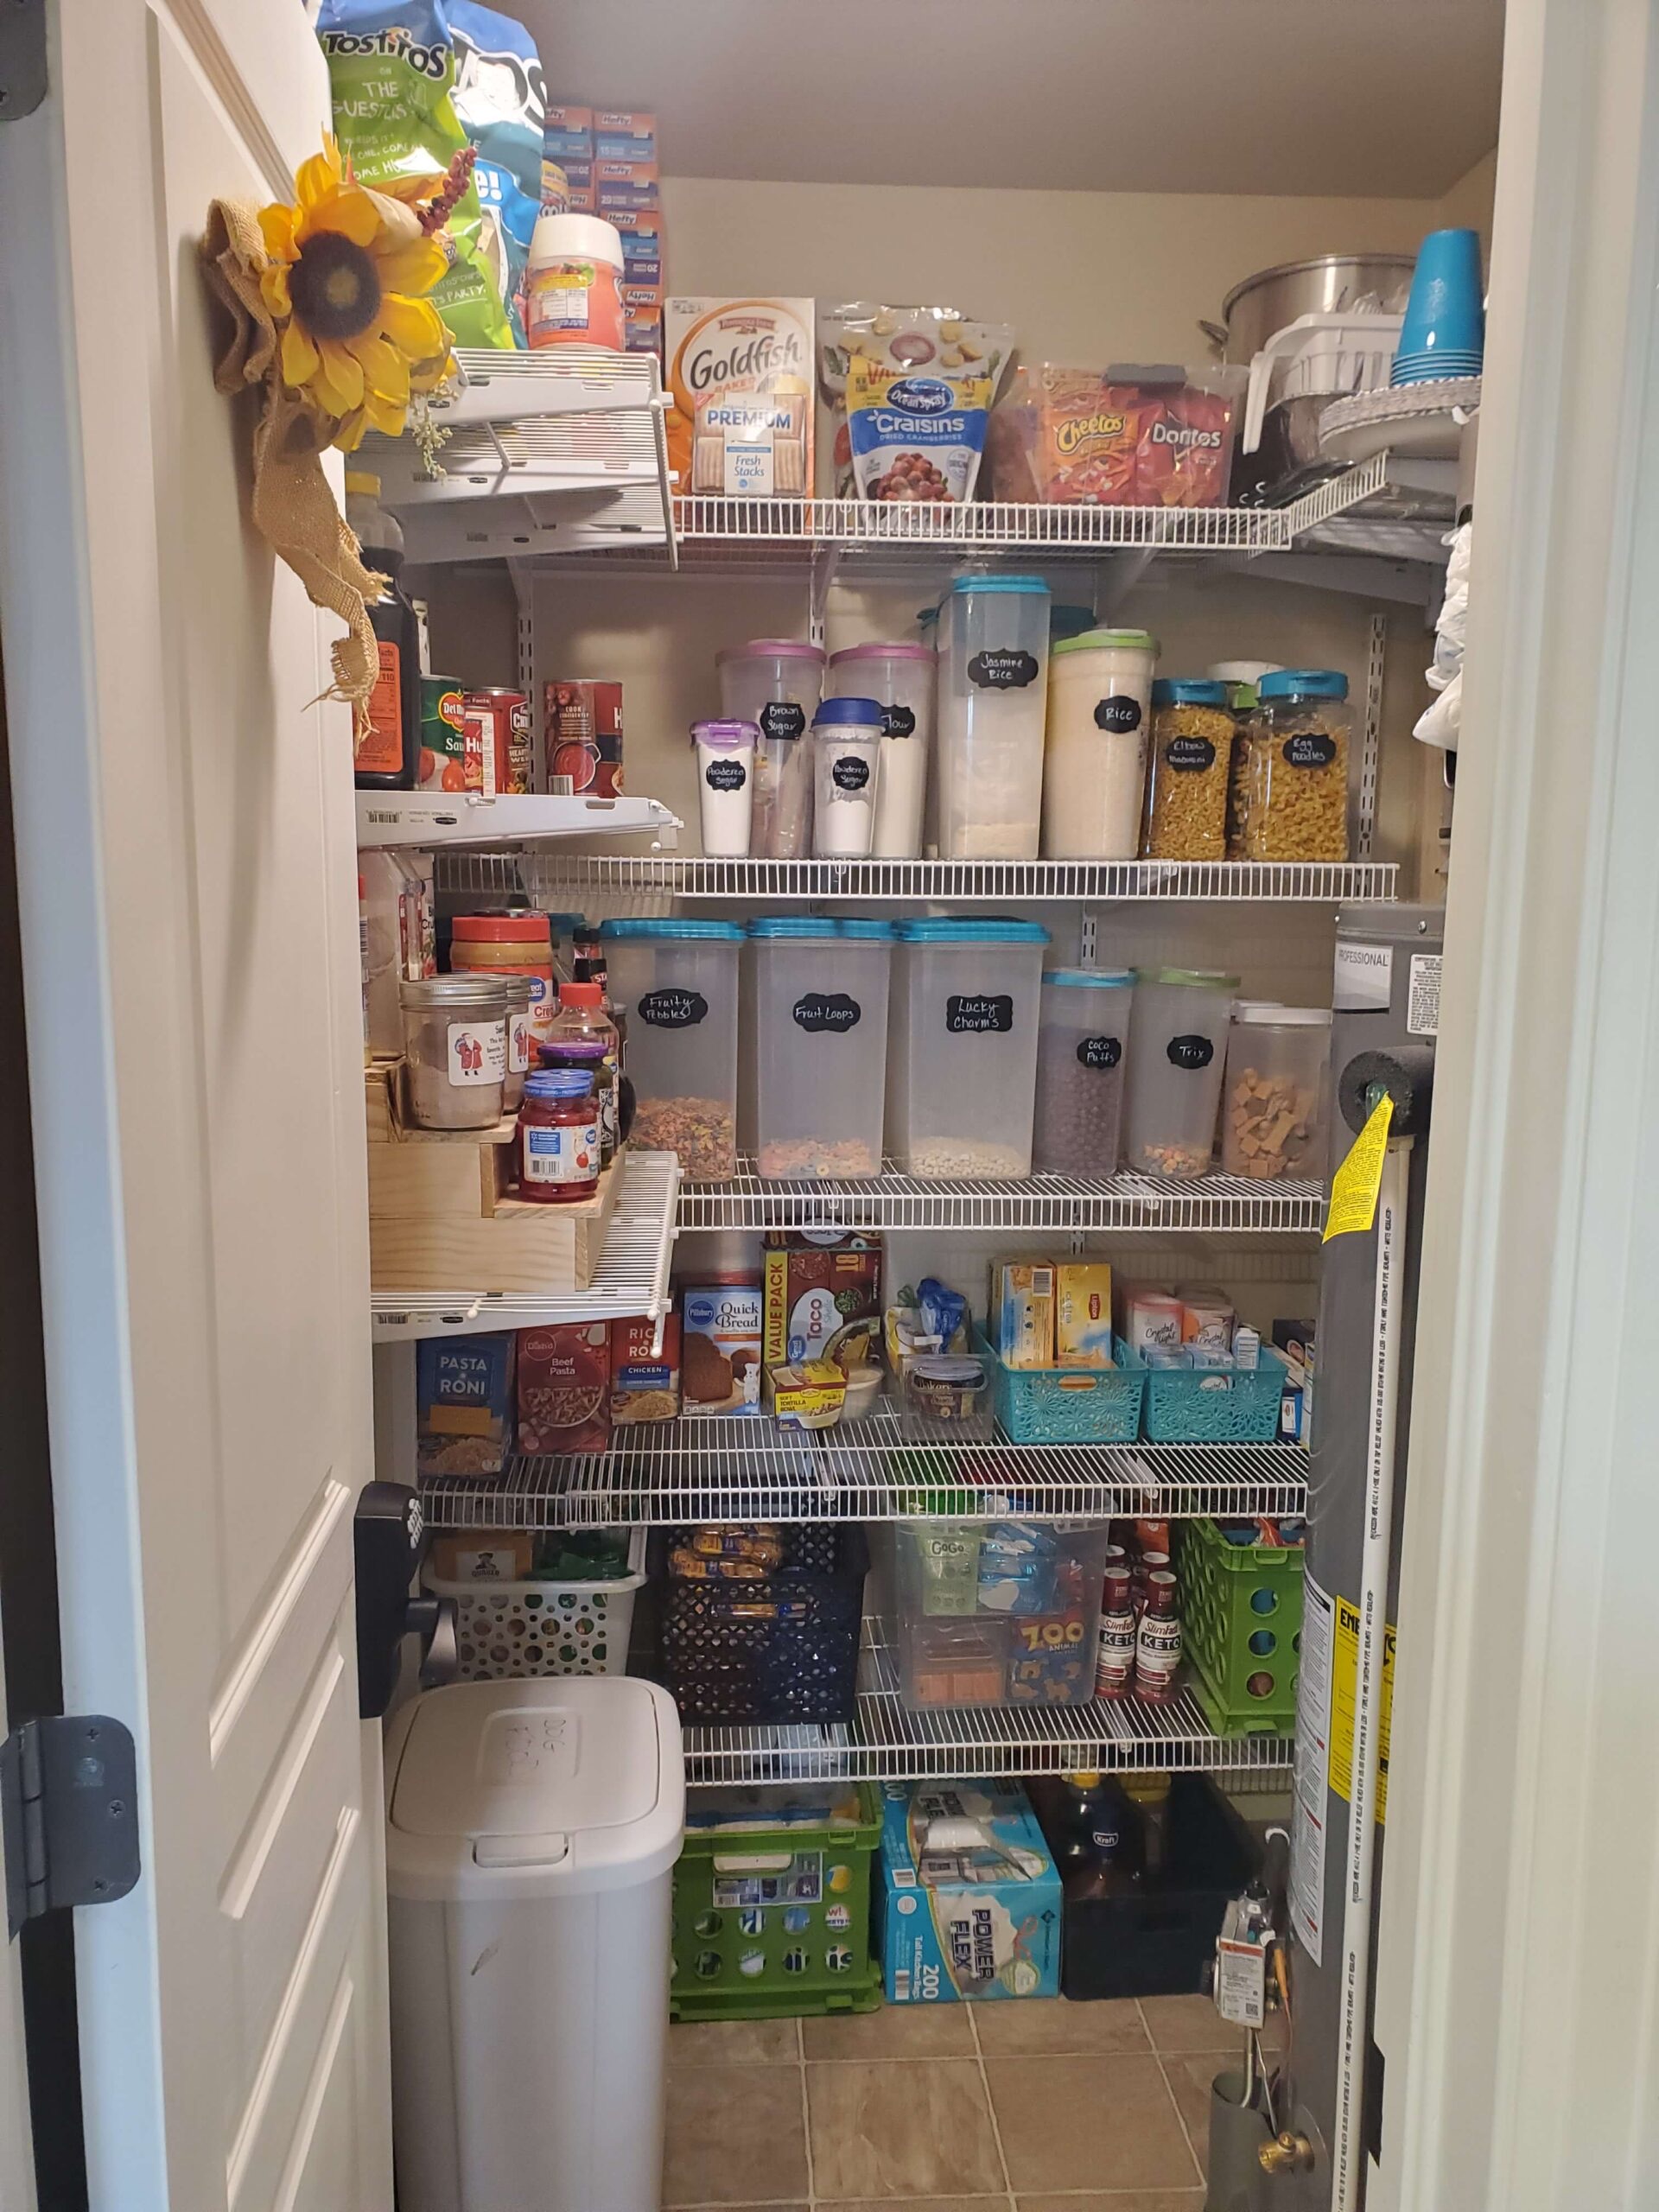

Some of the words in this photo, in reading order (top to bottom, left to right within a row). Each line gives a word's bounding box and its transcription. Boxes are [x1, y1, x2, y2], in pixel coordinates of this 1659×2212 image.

[362, 81, 399, 98] THE
[546, 109, 564, 119] efty
[607, 214, 635, 225] Hefty
[628, 289, 655, 302] Hefty
[690, 333, 800, 390] Goldfish
[707, 410, 791, 429] PREMUM
[876, 414, 965, 434] Craisins
[1057, 415, 1125, 454] Cheetos
[1152, 423, 1223, 448] Doritos
[735, 454, 761, 466] Fresh
[734, 466, 766, 478] Stacks
[980, 653, 1024, 670] Jasmine
[381, 672, 395, 682] 110
[988, 668, 1014, 681] Rice
[769, 705, 800, 717] Brown
[1105, 707, 1134, 721] Rice
[767, 720, 798, 734] Sugar
[1293, 738, 1313, 752] Egg
[649, 995, 695, 1010] Fruity
[957, 998, 1000, 1015] Lucky
[795, 1006, 823, 1020] Fruit
[825, 1007, 855, 1021] Loops
[952, 1015, 1000, 1029] Charms
[1179, 1046, 1205, 1059] Trix
[836, 1254, 860, 1272] 18
[770, 1263, 783, 1307] PACK
[721, 1301, 760, 1318] Quick
[1090, 1295, 1099, 1319] Lipton
[715, 1313, 759, 1328] Bread
[806, 1298, 823, 1341] Taco
[629, 1327, 653, 1338] RIC
[769, 1311, 783, 1359] VALUE
[1146, 1322, 1174, 1343] Crystal
[629, 1346, 648, 1357] RO
[440, 1356, 487, 1371] PASTA
[551, 1357, 574, 1366] Beef
[550, 1367, 576, 1376] Pasta
[440, 1379, 486, 1395] RONI
[1020, 1621, 1084, 1652] ZOO
[1143, 1636, 1180, 1649] KETO
[920, 1797, 940, 1817] FLE
[1096, 1835, 1115, 1844] Kraft
[914, 1935, 924, 1951] Tall
[950, 1920, 973, 1970] FLEX
[972, 1909, 994, 1980] POWER
[922, 1964, 939, 1999] 200
